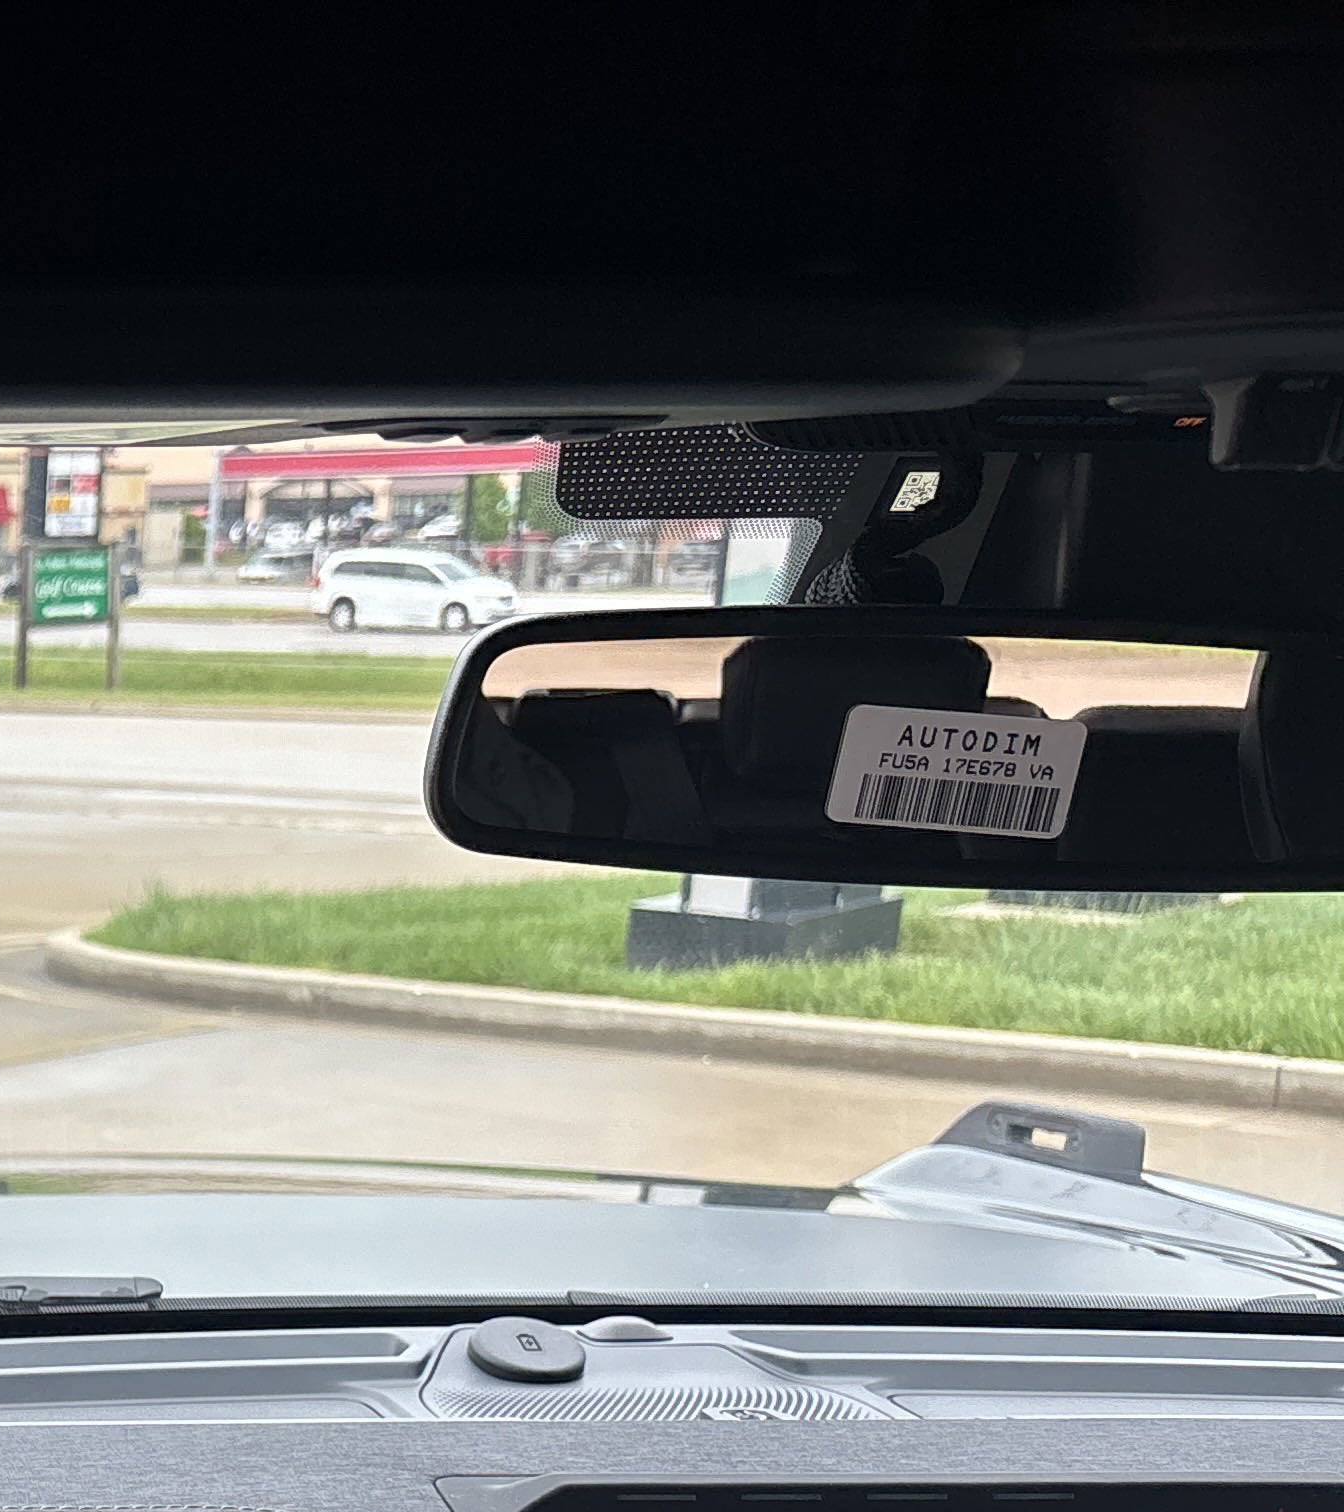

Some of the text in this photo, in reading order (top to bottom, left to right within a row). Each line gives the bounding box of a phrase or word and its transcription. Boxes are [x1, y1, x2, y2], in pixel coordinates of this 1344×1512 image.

[896, 724, 1042, 757] AUTODIM
[941, 757, 1018, 778] 17E678
[1029, 764, 1055, 782] VA
